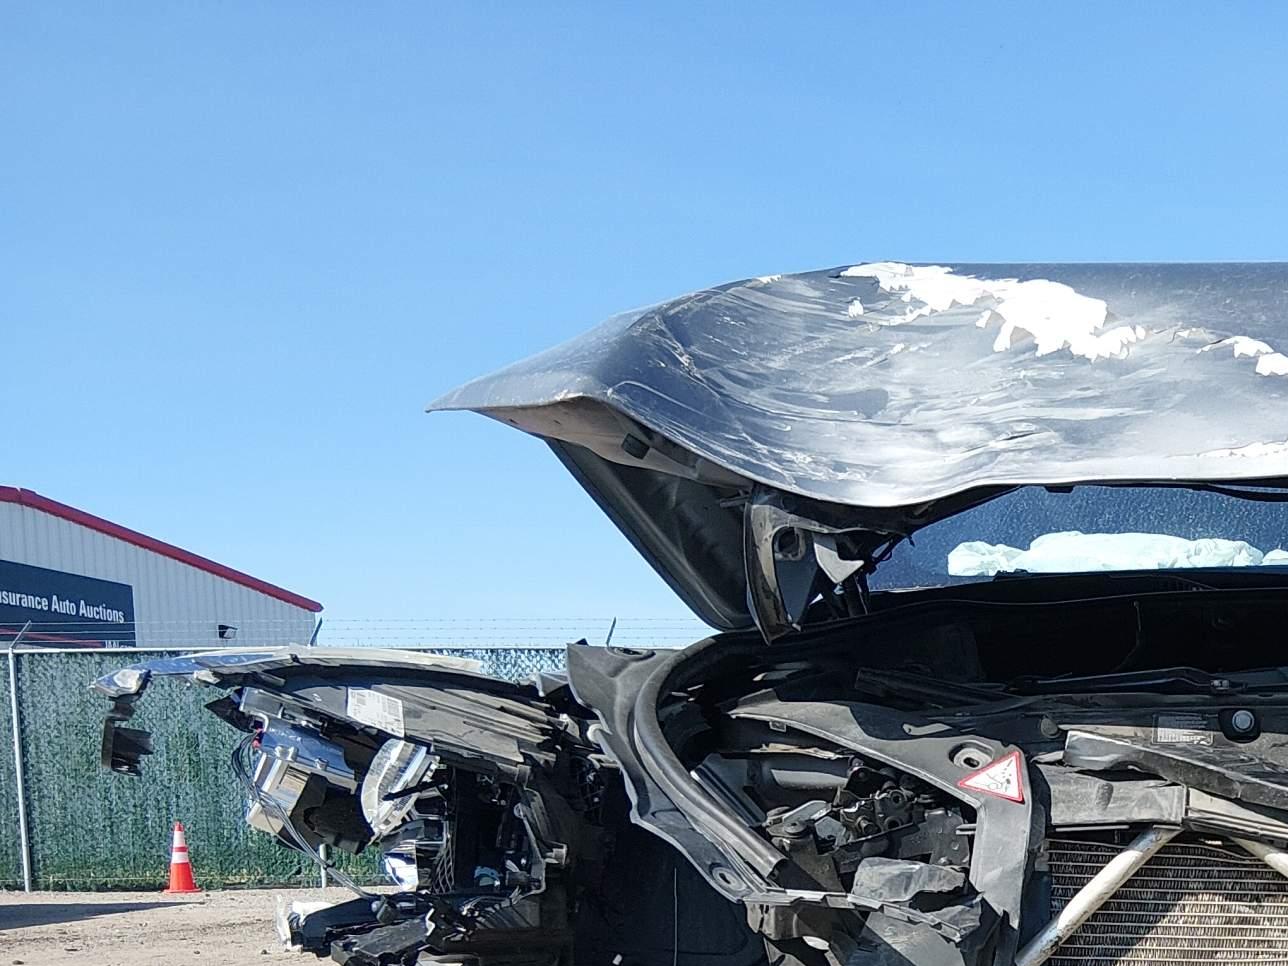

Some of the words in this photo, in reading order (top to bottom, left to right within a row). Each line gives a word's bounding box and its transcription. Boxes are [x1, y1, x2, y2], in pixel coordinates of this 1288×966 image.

[0, 590, 49, 611] surance
[51, 594, 77, 616] Auto
[79, 599, 125, 624] Auctions
